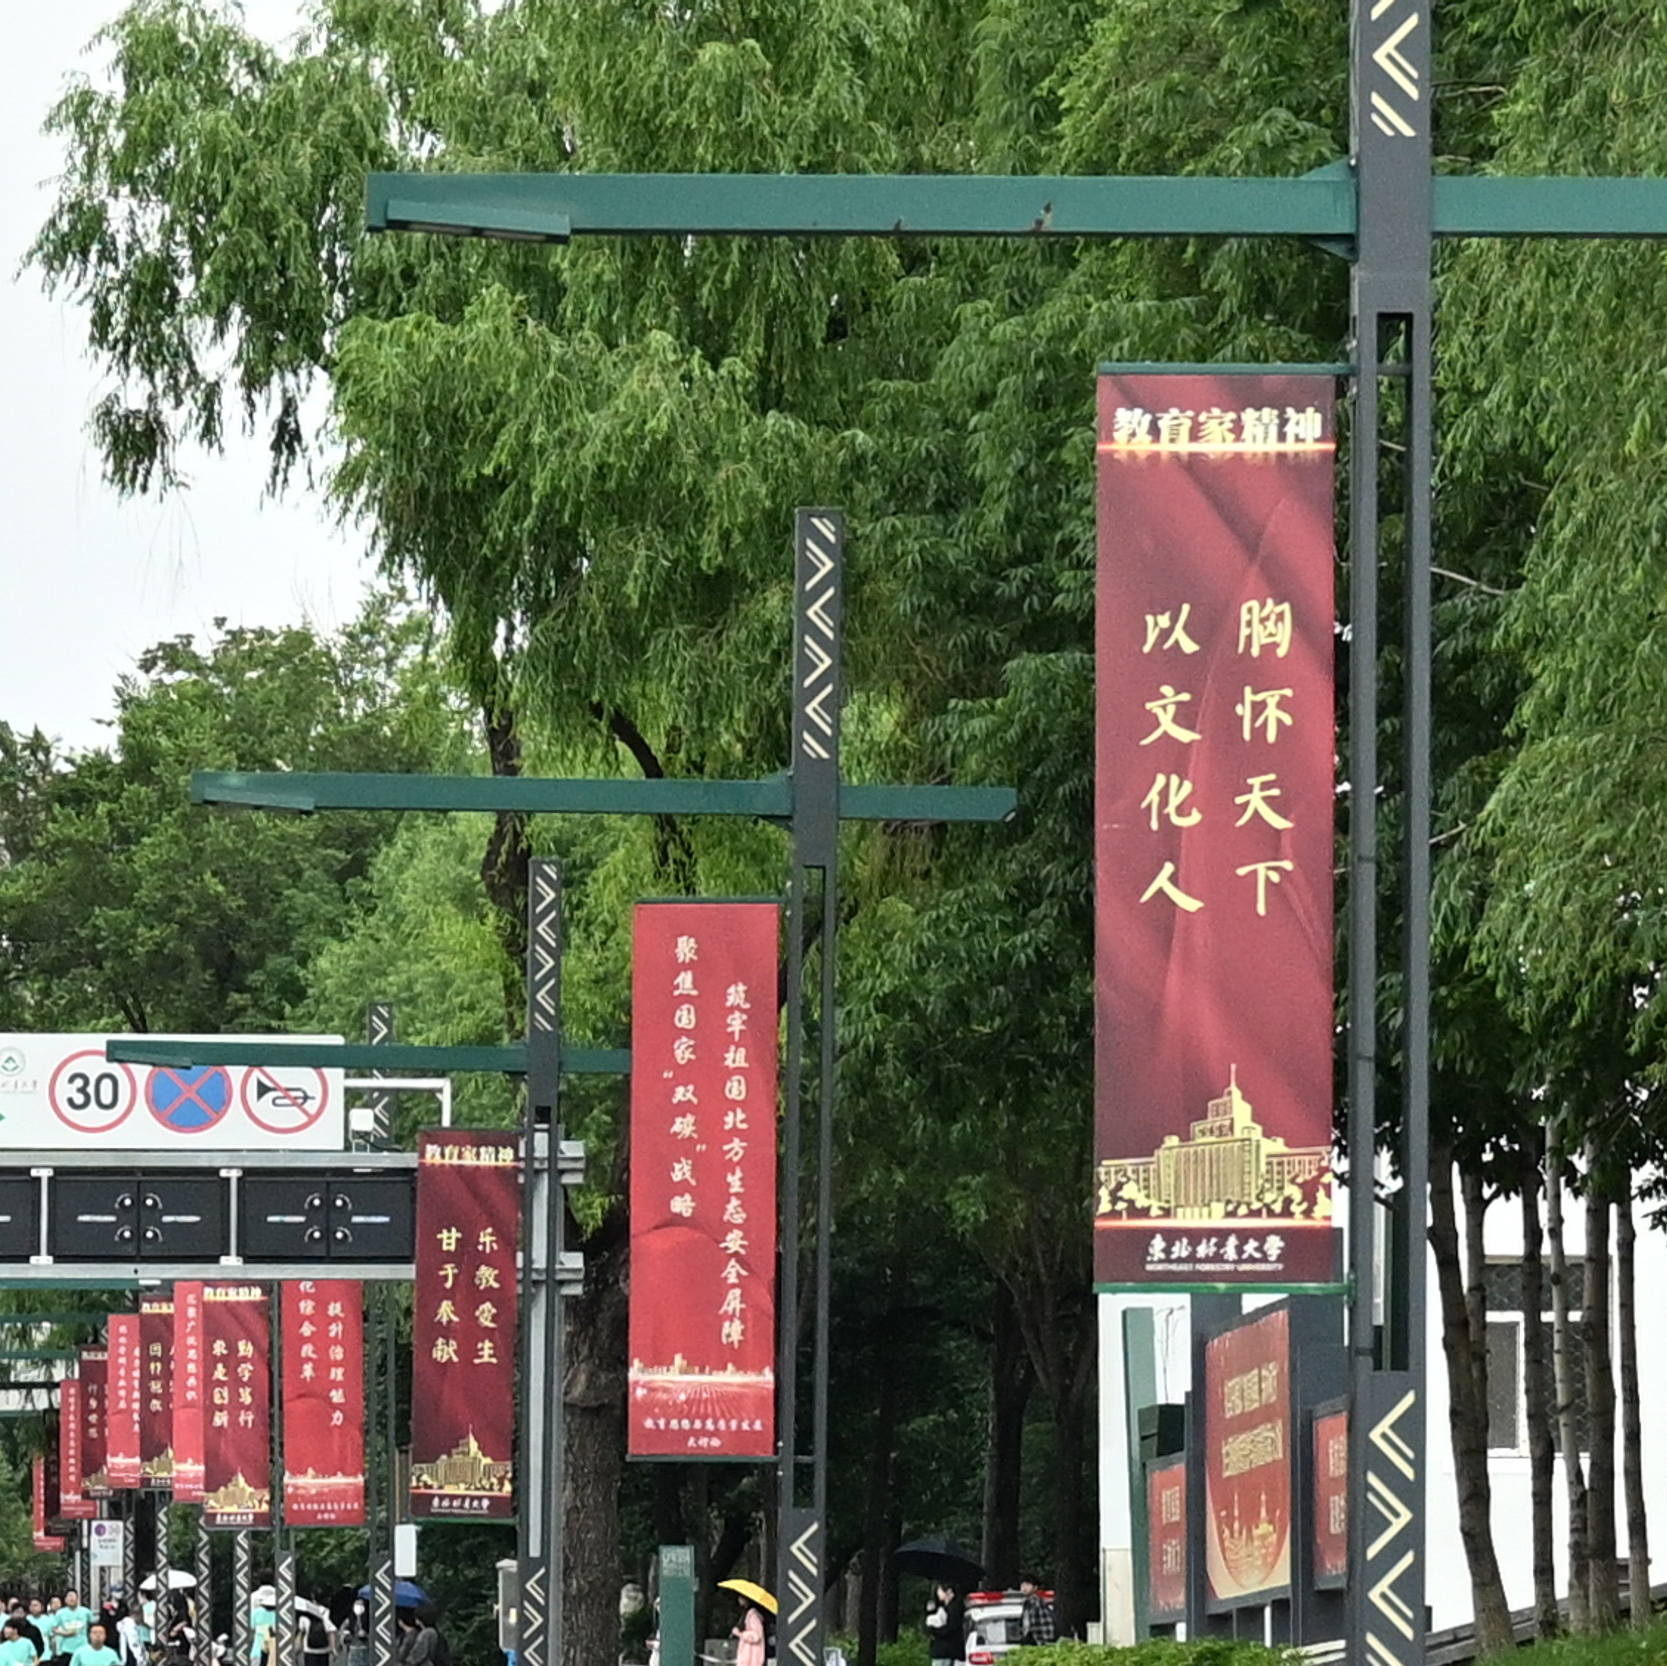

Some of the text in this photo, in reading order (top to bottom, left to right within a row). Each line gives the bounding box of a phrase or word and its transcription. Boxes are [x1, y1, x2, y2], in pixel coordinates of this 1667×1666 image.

[1113, 407, 1323, 446] 教育家精神
[1139, 603, 1204, 912] 以文化人
[1235, 598, 1294, 916] 胸怀天下
[66, 1072, 119, 1111] 30
[719, 982, 751, 1349] 筑牢祖国北方生态安全屏障
[432, 1227, 462, 1363] 甘于奉献
